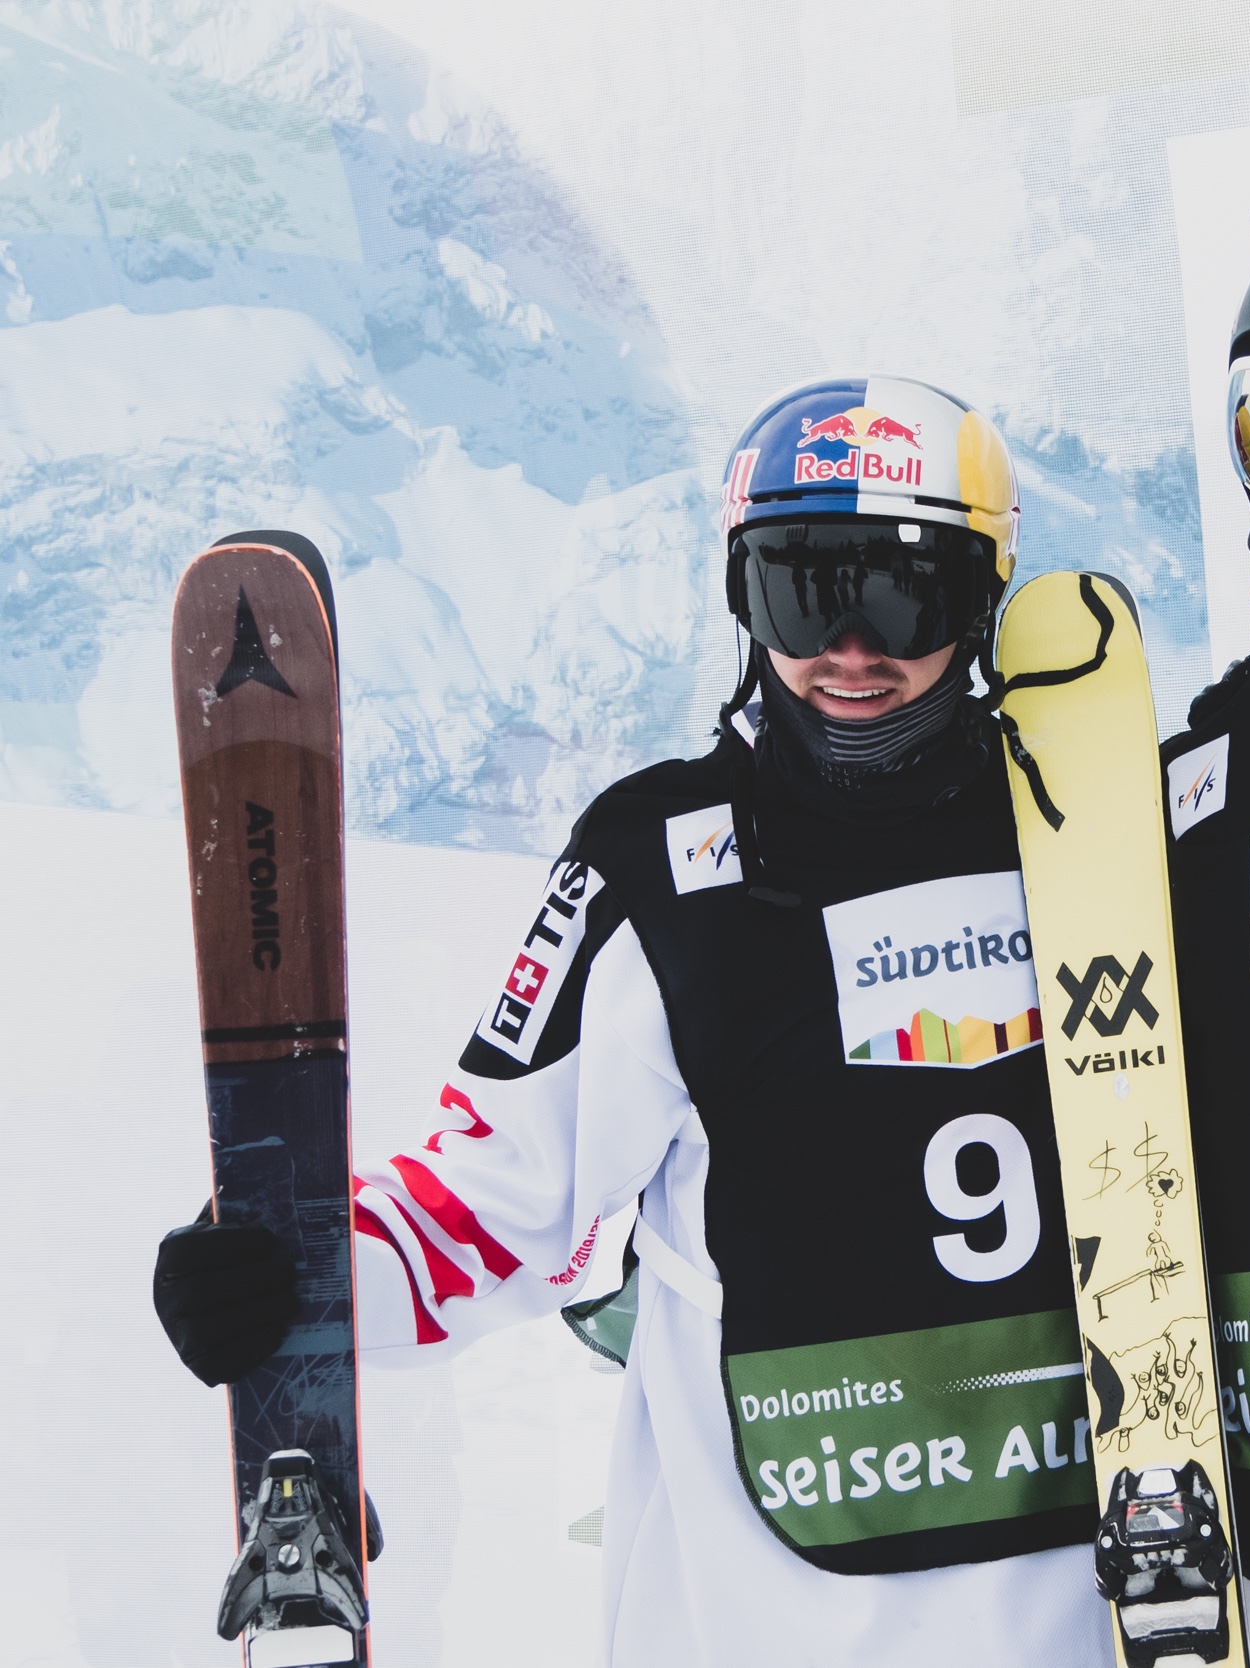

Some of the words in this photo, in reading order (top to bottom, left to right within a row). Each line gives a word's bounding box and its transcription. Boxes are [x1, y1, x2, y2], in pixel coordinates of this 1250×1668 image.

[795, 450, 857, 484] Red
[862, 453, 922, 486] Bull
[245, 801, 281, 971] ATOMIC
[923, 1113, 1041, 1282] 9
[740, 1378, 904, 1422] Dolomites
